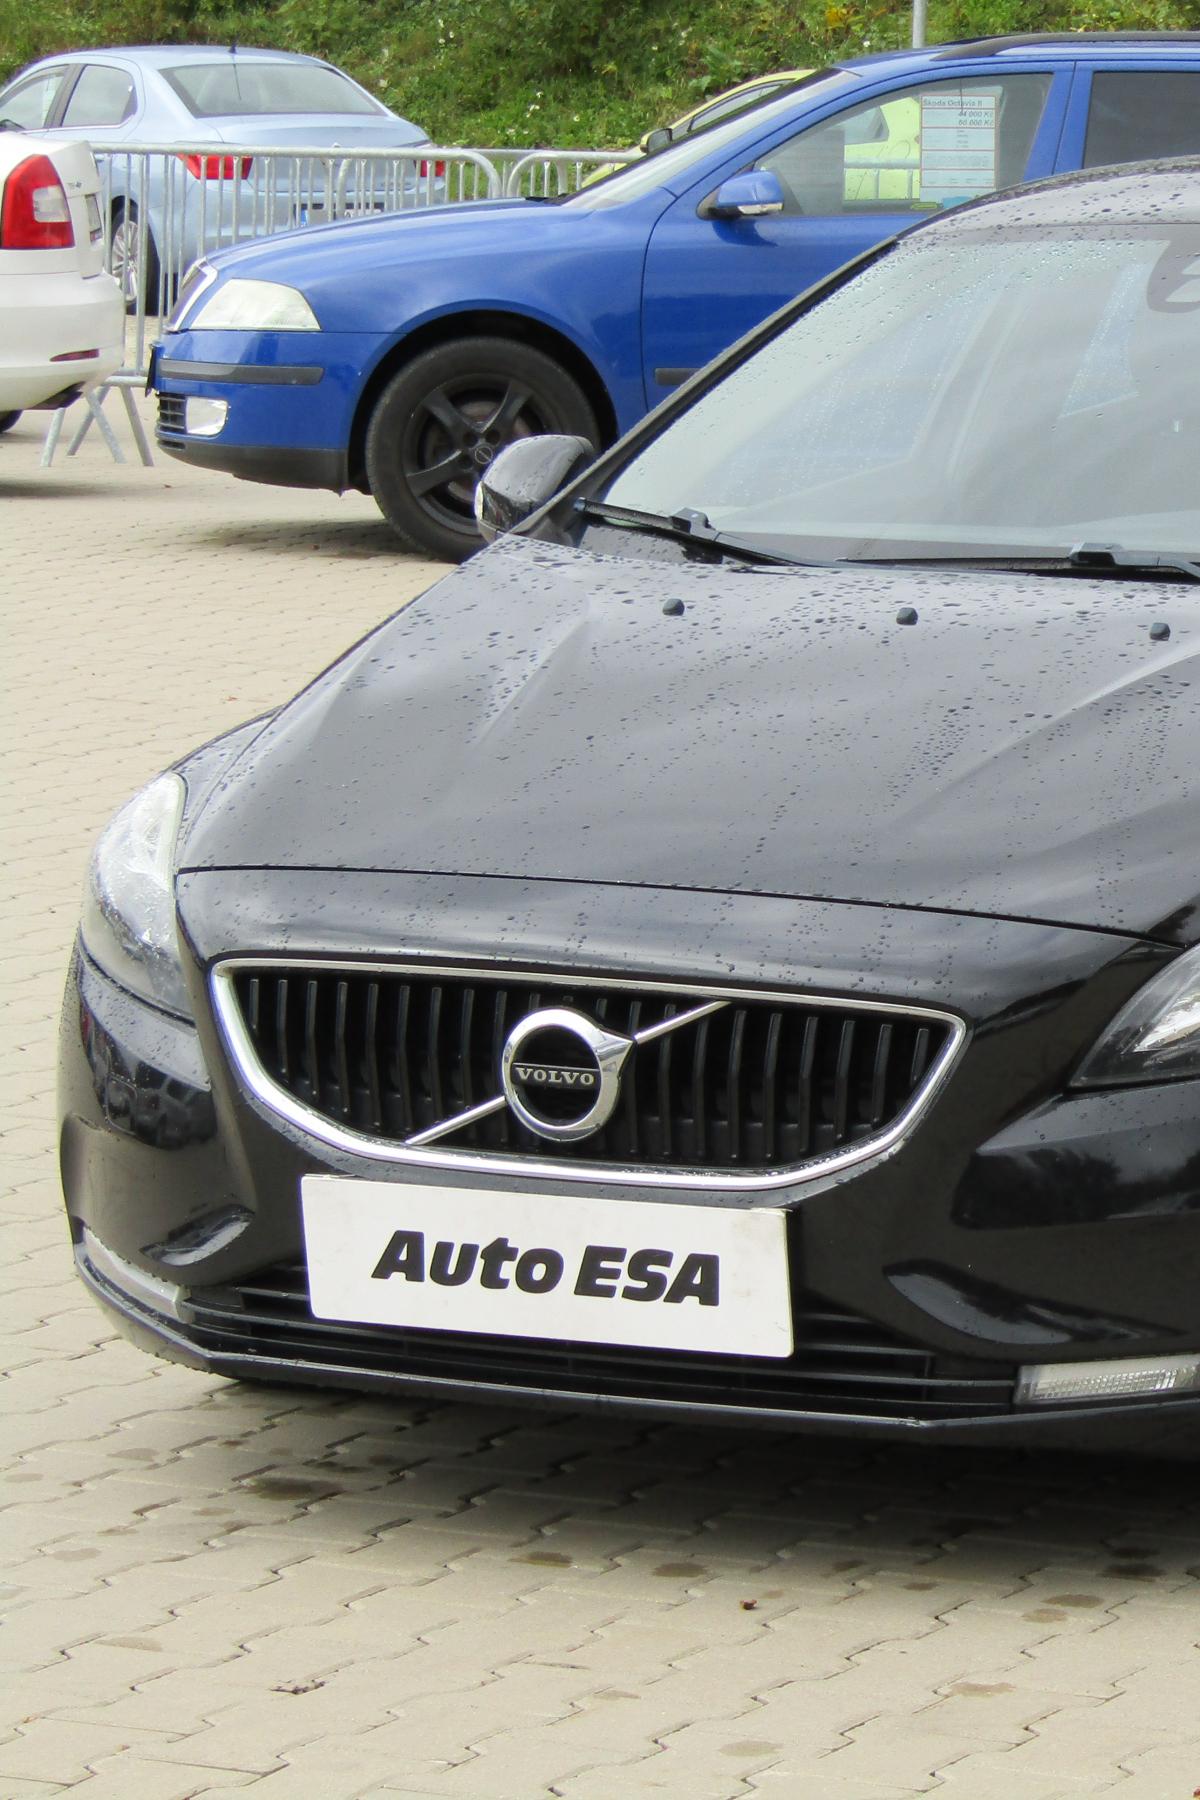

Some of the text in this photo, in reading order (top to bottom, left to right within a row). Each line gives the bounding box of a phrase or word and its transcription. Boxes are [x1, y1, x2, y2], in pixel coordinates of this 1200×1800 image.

[515, 1067, 595, 1086] VOLVO
[371, 1229, 720, 1307] Auto ESA
